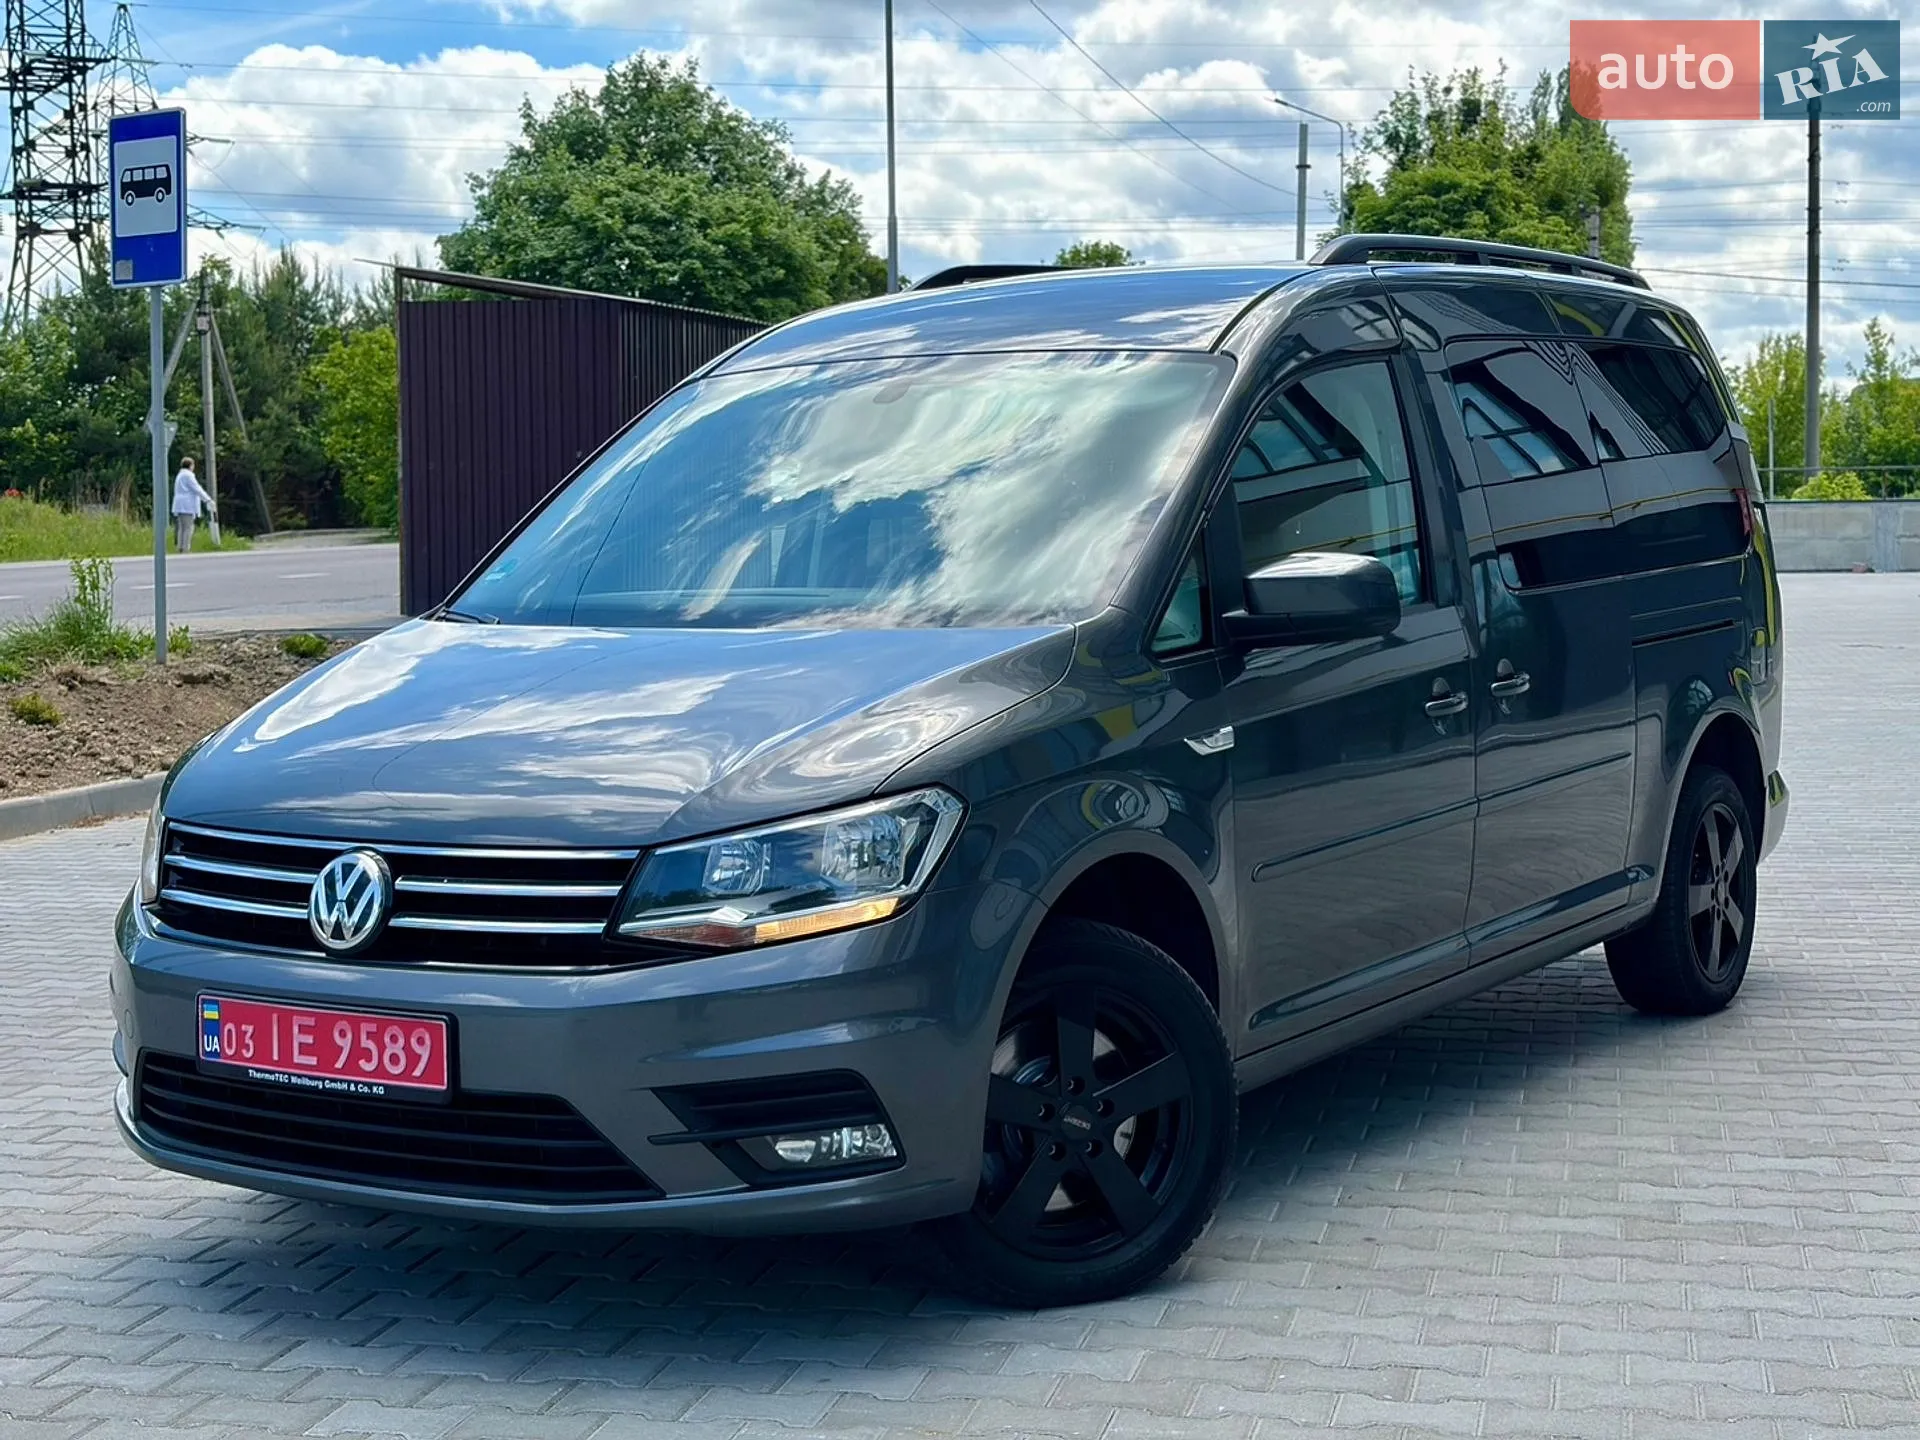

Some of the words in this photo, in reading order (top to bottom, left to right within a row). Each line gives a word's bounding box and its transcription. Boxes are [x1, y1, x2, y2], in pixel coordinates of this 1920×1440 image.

[203, 1034, 220, 1053] UA
[223, 1022, 255, 1058] 03
[272, 1013, 318, 1066] IE
[333, 1020, 432, 1078] 9589
[324, 1079, 348, 1091] GmbH
[350, 1083, 356, 1092] &
[357, 1083, 371, 1093] Co.
[372, 1085, 385, 1095] KG
